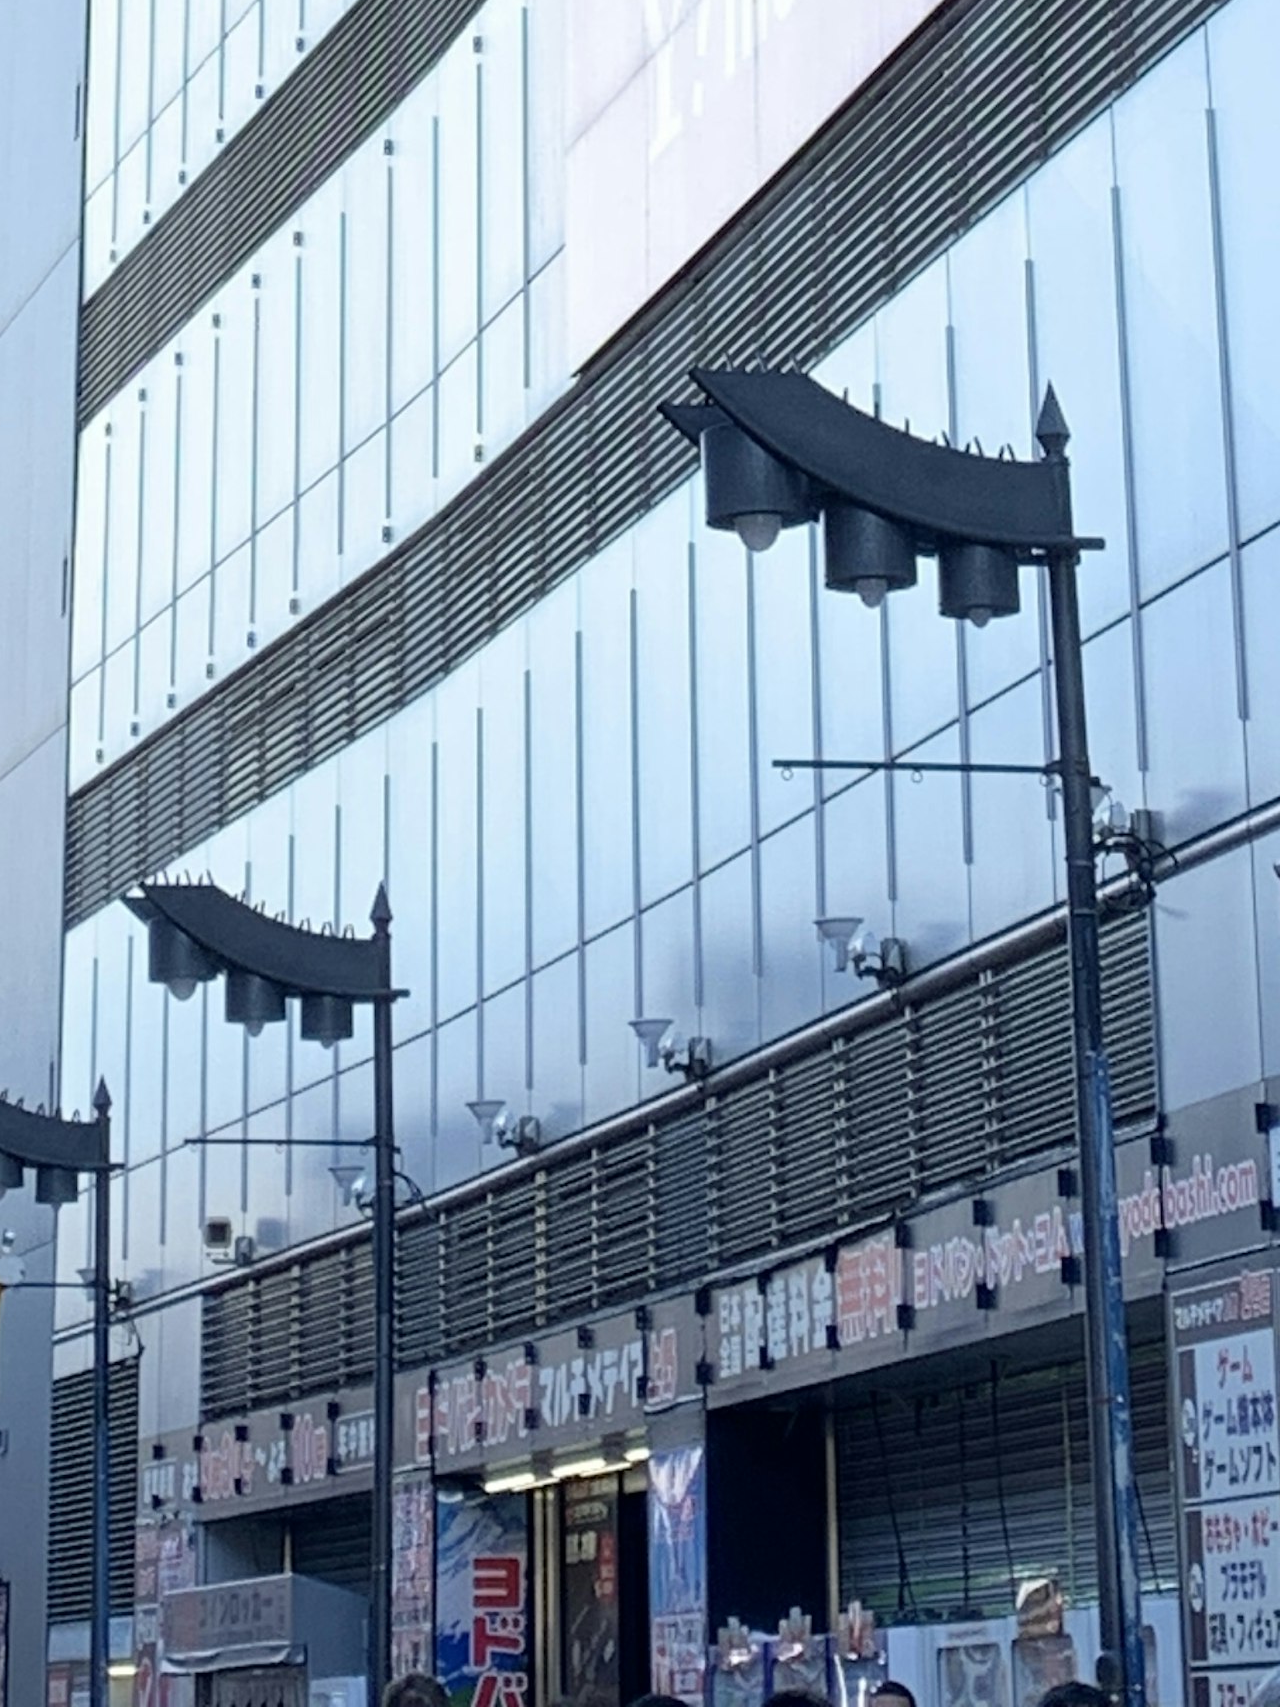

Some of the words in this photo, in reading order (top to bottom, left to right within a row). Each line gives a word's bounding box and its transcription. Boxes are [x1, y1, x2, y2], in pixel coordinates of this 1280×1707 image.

[1217, 1344, 1254, 1389] ゲーム
[1204, 1442, 1277, 1489] ゲームソフト
